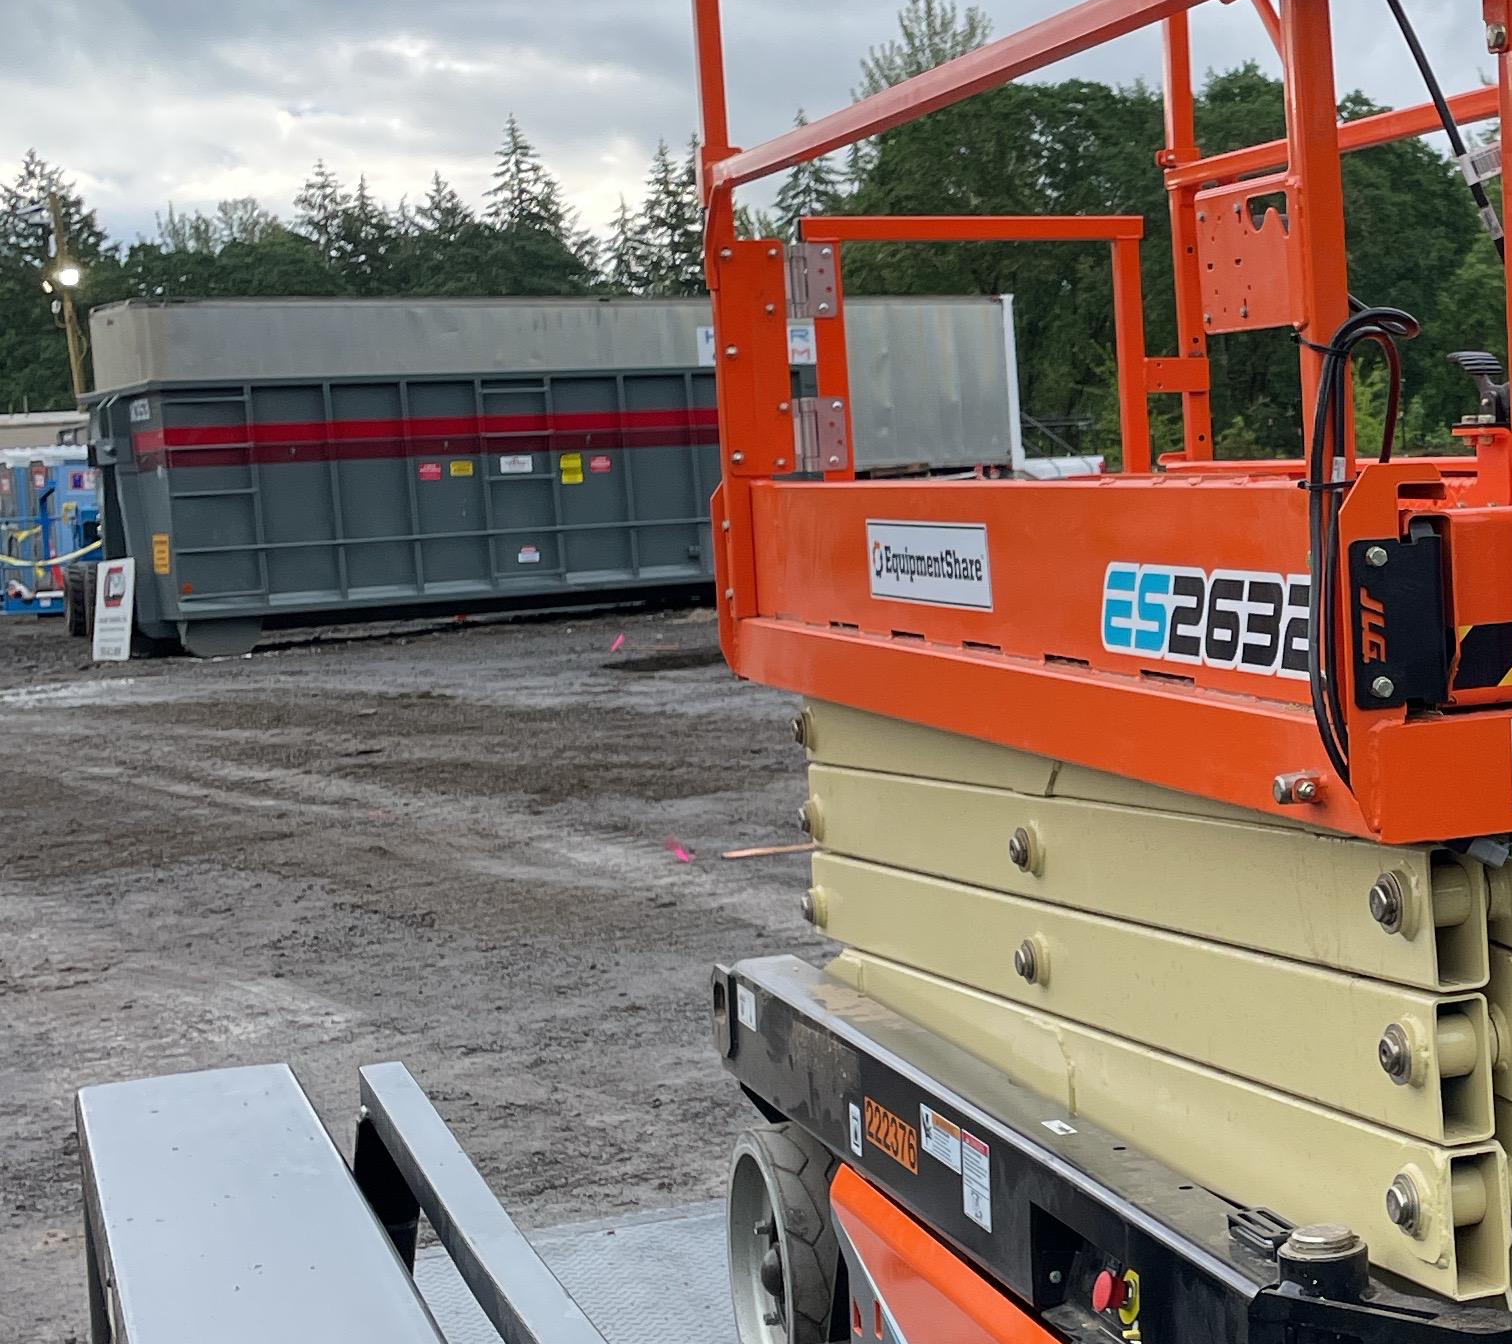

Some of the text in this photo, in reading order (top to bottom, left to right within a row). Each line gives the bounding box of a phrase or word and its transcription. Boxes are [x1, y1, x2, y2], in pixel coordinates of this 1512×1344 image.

[885, 545, 983, 582] EquipmentShare
[1359, 586, 1387, 664] JLG
[866, 1100, 917, 1170] 222376
